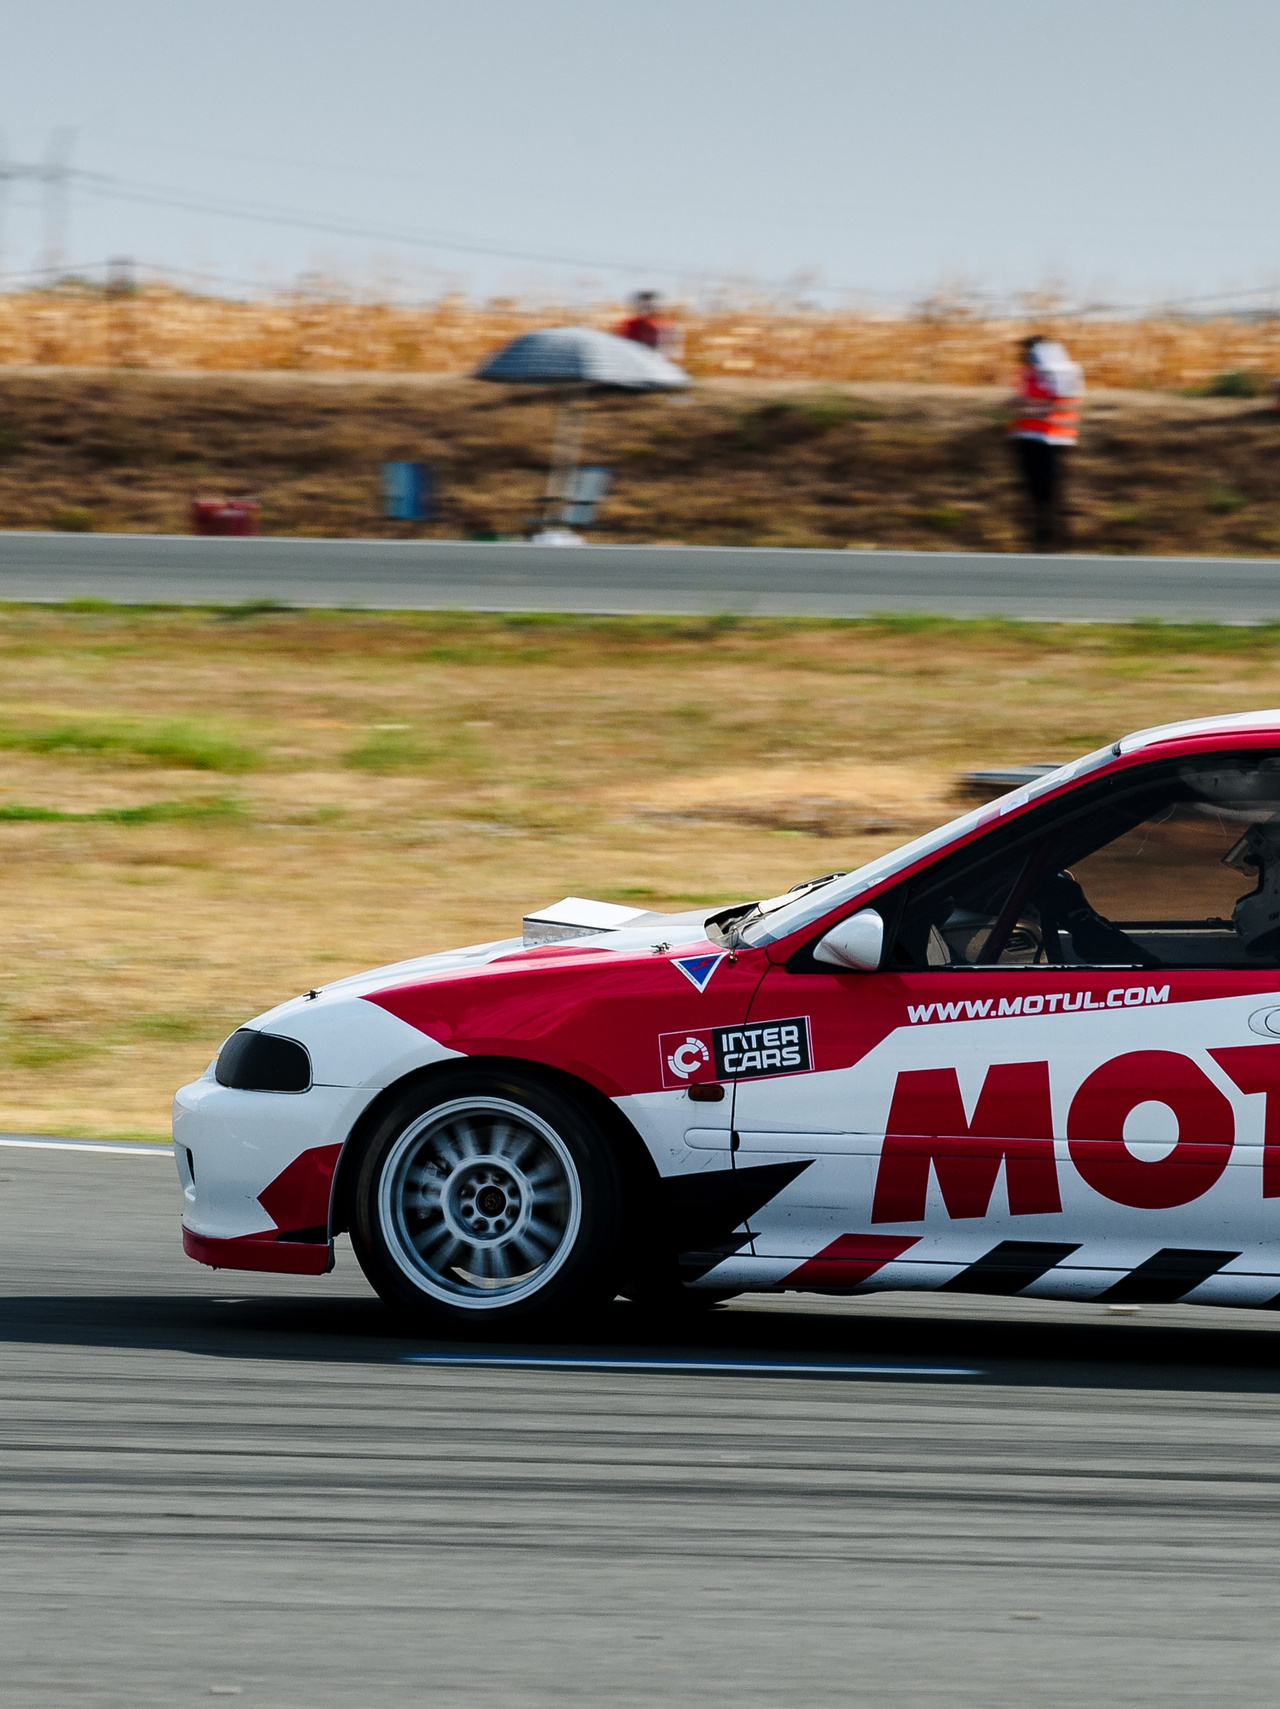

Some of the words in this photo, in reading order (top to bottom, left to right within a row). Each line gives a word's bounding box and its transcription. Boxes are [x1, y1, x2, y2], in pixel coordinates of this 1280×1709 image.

[907, 985, 1170, 1023] WWW.MOTUL.COM
[721, 1025, 799, 1052] INTER
[723, 1046, 802, 1073] CARS
